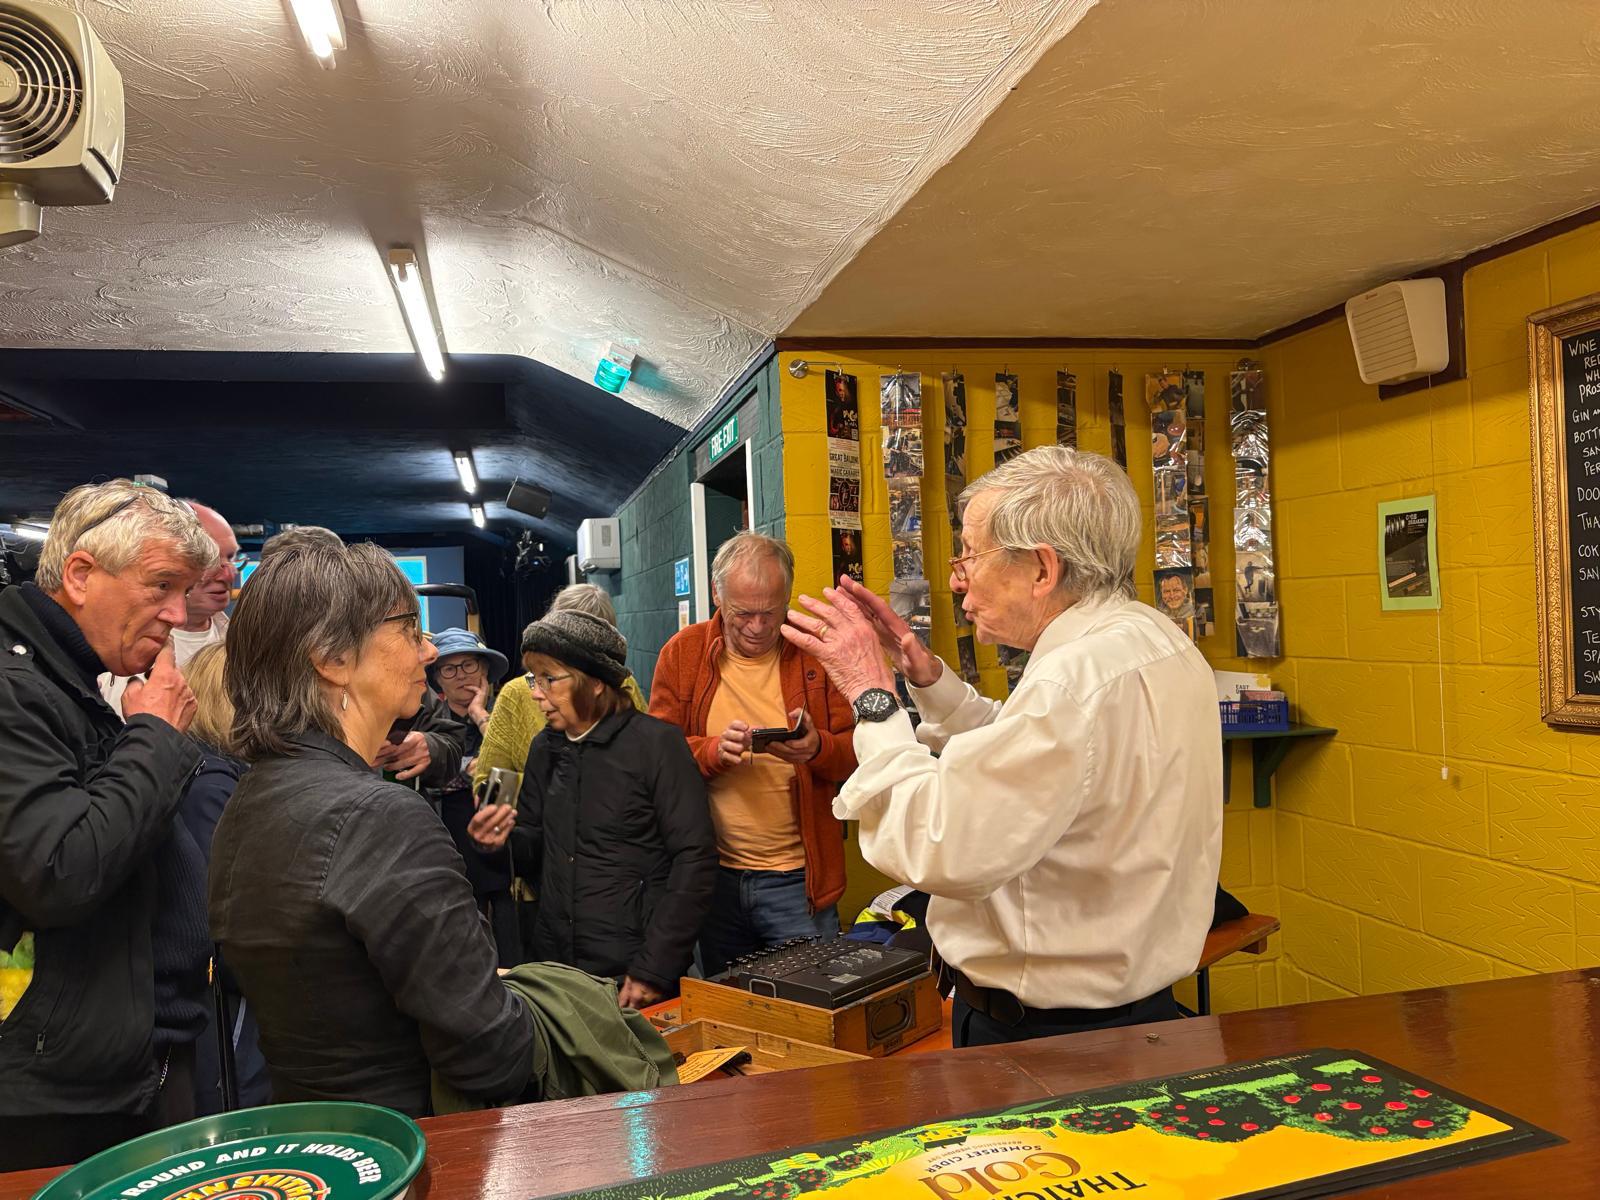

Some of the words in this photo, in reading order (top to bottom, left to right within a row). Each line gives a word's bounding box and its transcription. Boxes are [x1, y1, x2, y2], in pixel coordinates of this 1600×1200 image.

[1568, 339, 1597, 357] WINE
[1572, 409, 1590, 423] GIN
[1577, 486, 1600, 502] DOO
[1578, 544, 1600, 558] COK
[1579, 565, 1600, 581] SAN
[1582, 630, 1600, 644] TE
[967, 1145, 1042, 1159] SOMERSET
[120, 1160, 206, 1197] ROUND
[216, 1146, 267, 1164] AND
[273, 1143, 300, 1155] IT
[300, 1143, 365, 1161] HOLDS
[351, 1157, 382, 1185] BEER
[925, 1155, 963, 1174] CIDER
[918, 1152, 1081, 1200] Gold
